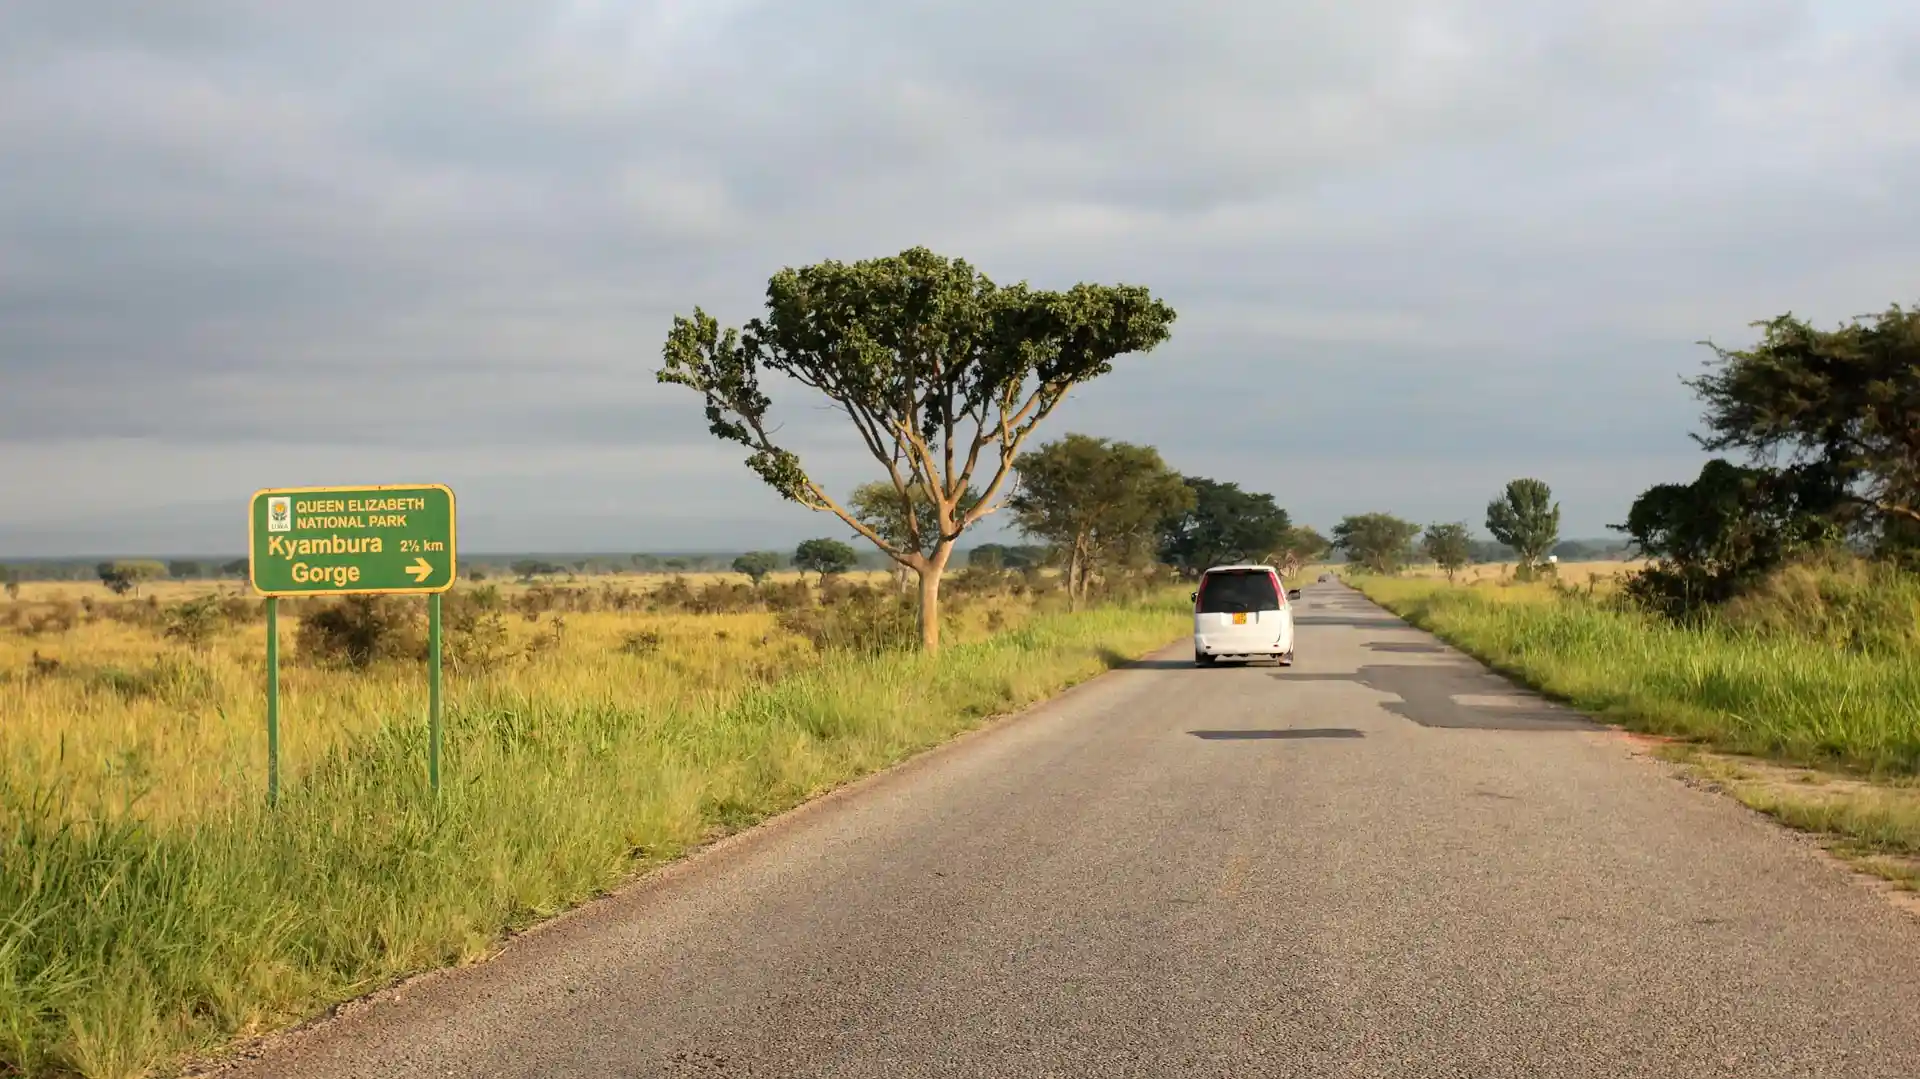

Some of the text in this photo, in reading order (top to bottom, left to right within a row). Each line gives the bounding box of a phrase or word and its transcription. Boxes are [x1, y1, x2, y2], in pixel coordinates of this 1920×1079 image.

[296, 498, 424, 513] QUEEN ELIZABETH
[297, 515, 406, 529] NATIONAL PARK
[268, 535, 382, 560] Kyambura
[424, 540, 444, 551] km
[292, 562, 360, 587] Gorge
